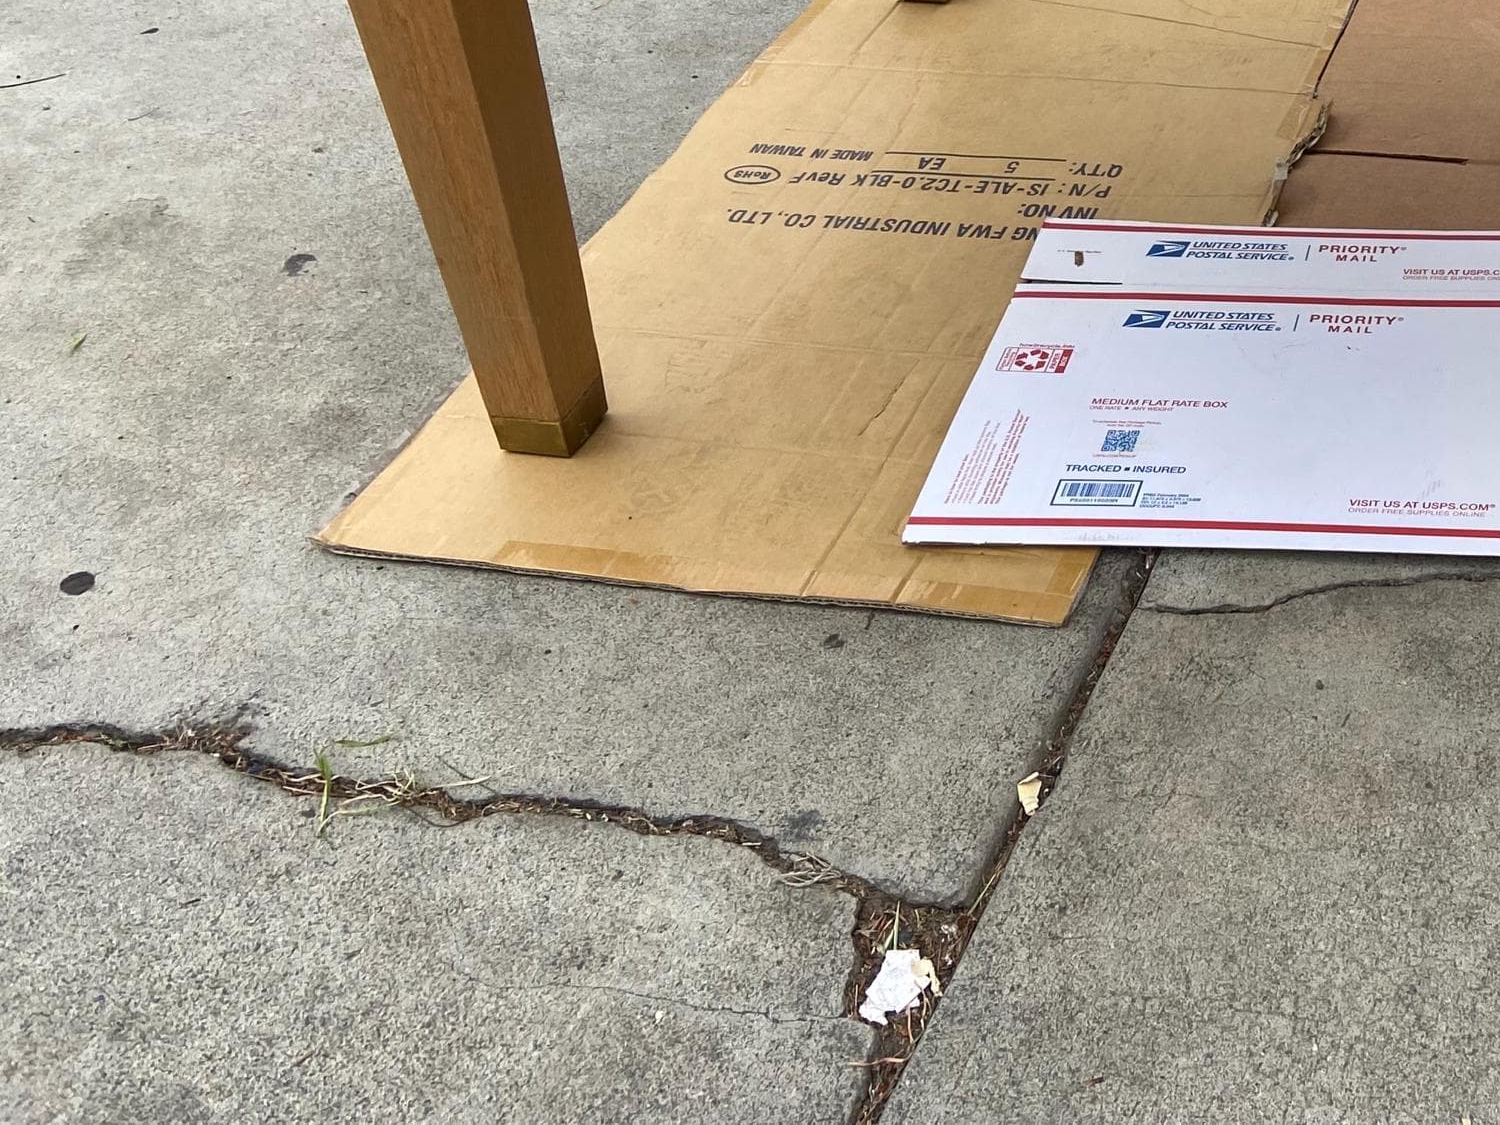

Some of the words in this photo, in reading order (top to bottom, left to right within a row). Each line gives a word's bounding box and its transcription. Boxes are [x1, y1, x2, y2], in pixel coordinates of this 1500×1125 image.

[749, 143, 806, 156] TAIWAN
[809, 148, 829, 159] IN
[829, 149, 874, 161] MADE
[917, 157, 947, 171] EA
[1004, 161, 1020, 174] 5
[733, 170, 772, 180] RoHS
[727, 209, 774, 225] LTD.
[1058, 207, 1100, 219] INV
[822, 214, 951, 236] INDUSTRIAL
[956, 223, 1008, 239] FWA
[1193, 241, 1240, 250] UNITED
[1242, 242, 1289, 251] STATES
[1186, 250, 1234, 260] POSTAL
[1335, 254, 1379, 263] MAIL
[1173, 310, 1221, 320] UNITED
[1222, 312, 1275, 321] STATES
[1165, 321, 1219, 331] POSTAL
[1328, 325, 1373, 334] MAIL
[1091, 397, 1140, 406] MEDIUM
[1141, 398, 1169, 407] FLAT
[1170, 399, 1202, 407] RATE
[1202, 400, 1229, 408] BOX
[1065, 464, 1122, 473] TRACKED
[1132, 465, 1187, 474] INSURED
[1349, 499, 1380, 507] VISIT
[1383, 500, 1401, 508] US
[1403, 501, 1420, 509] AT
[1406, 509, 1450, 517] SUPPLIES
[1452, 510, 1486, 518] ONLINE
